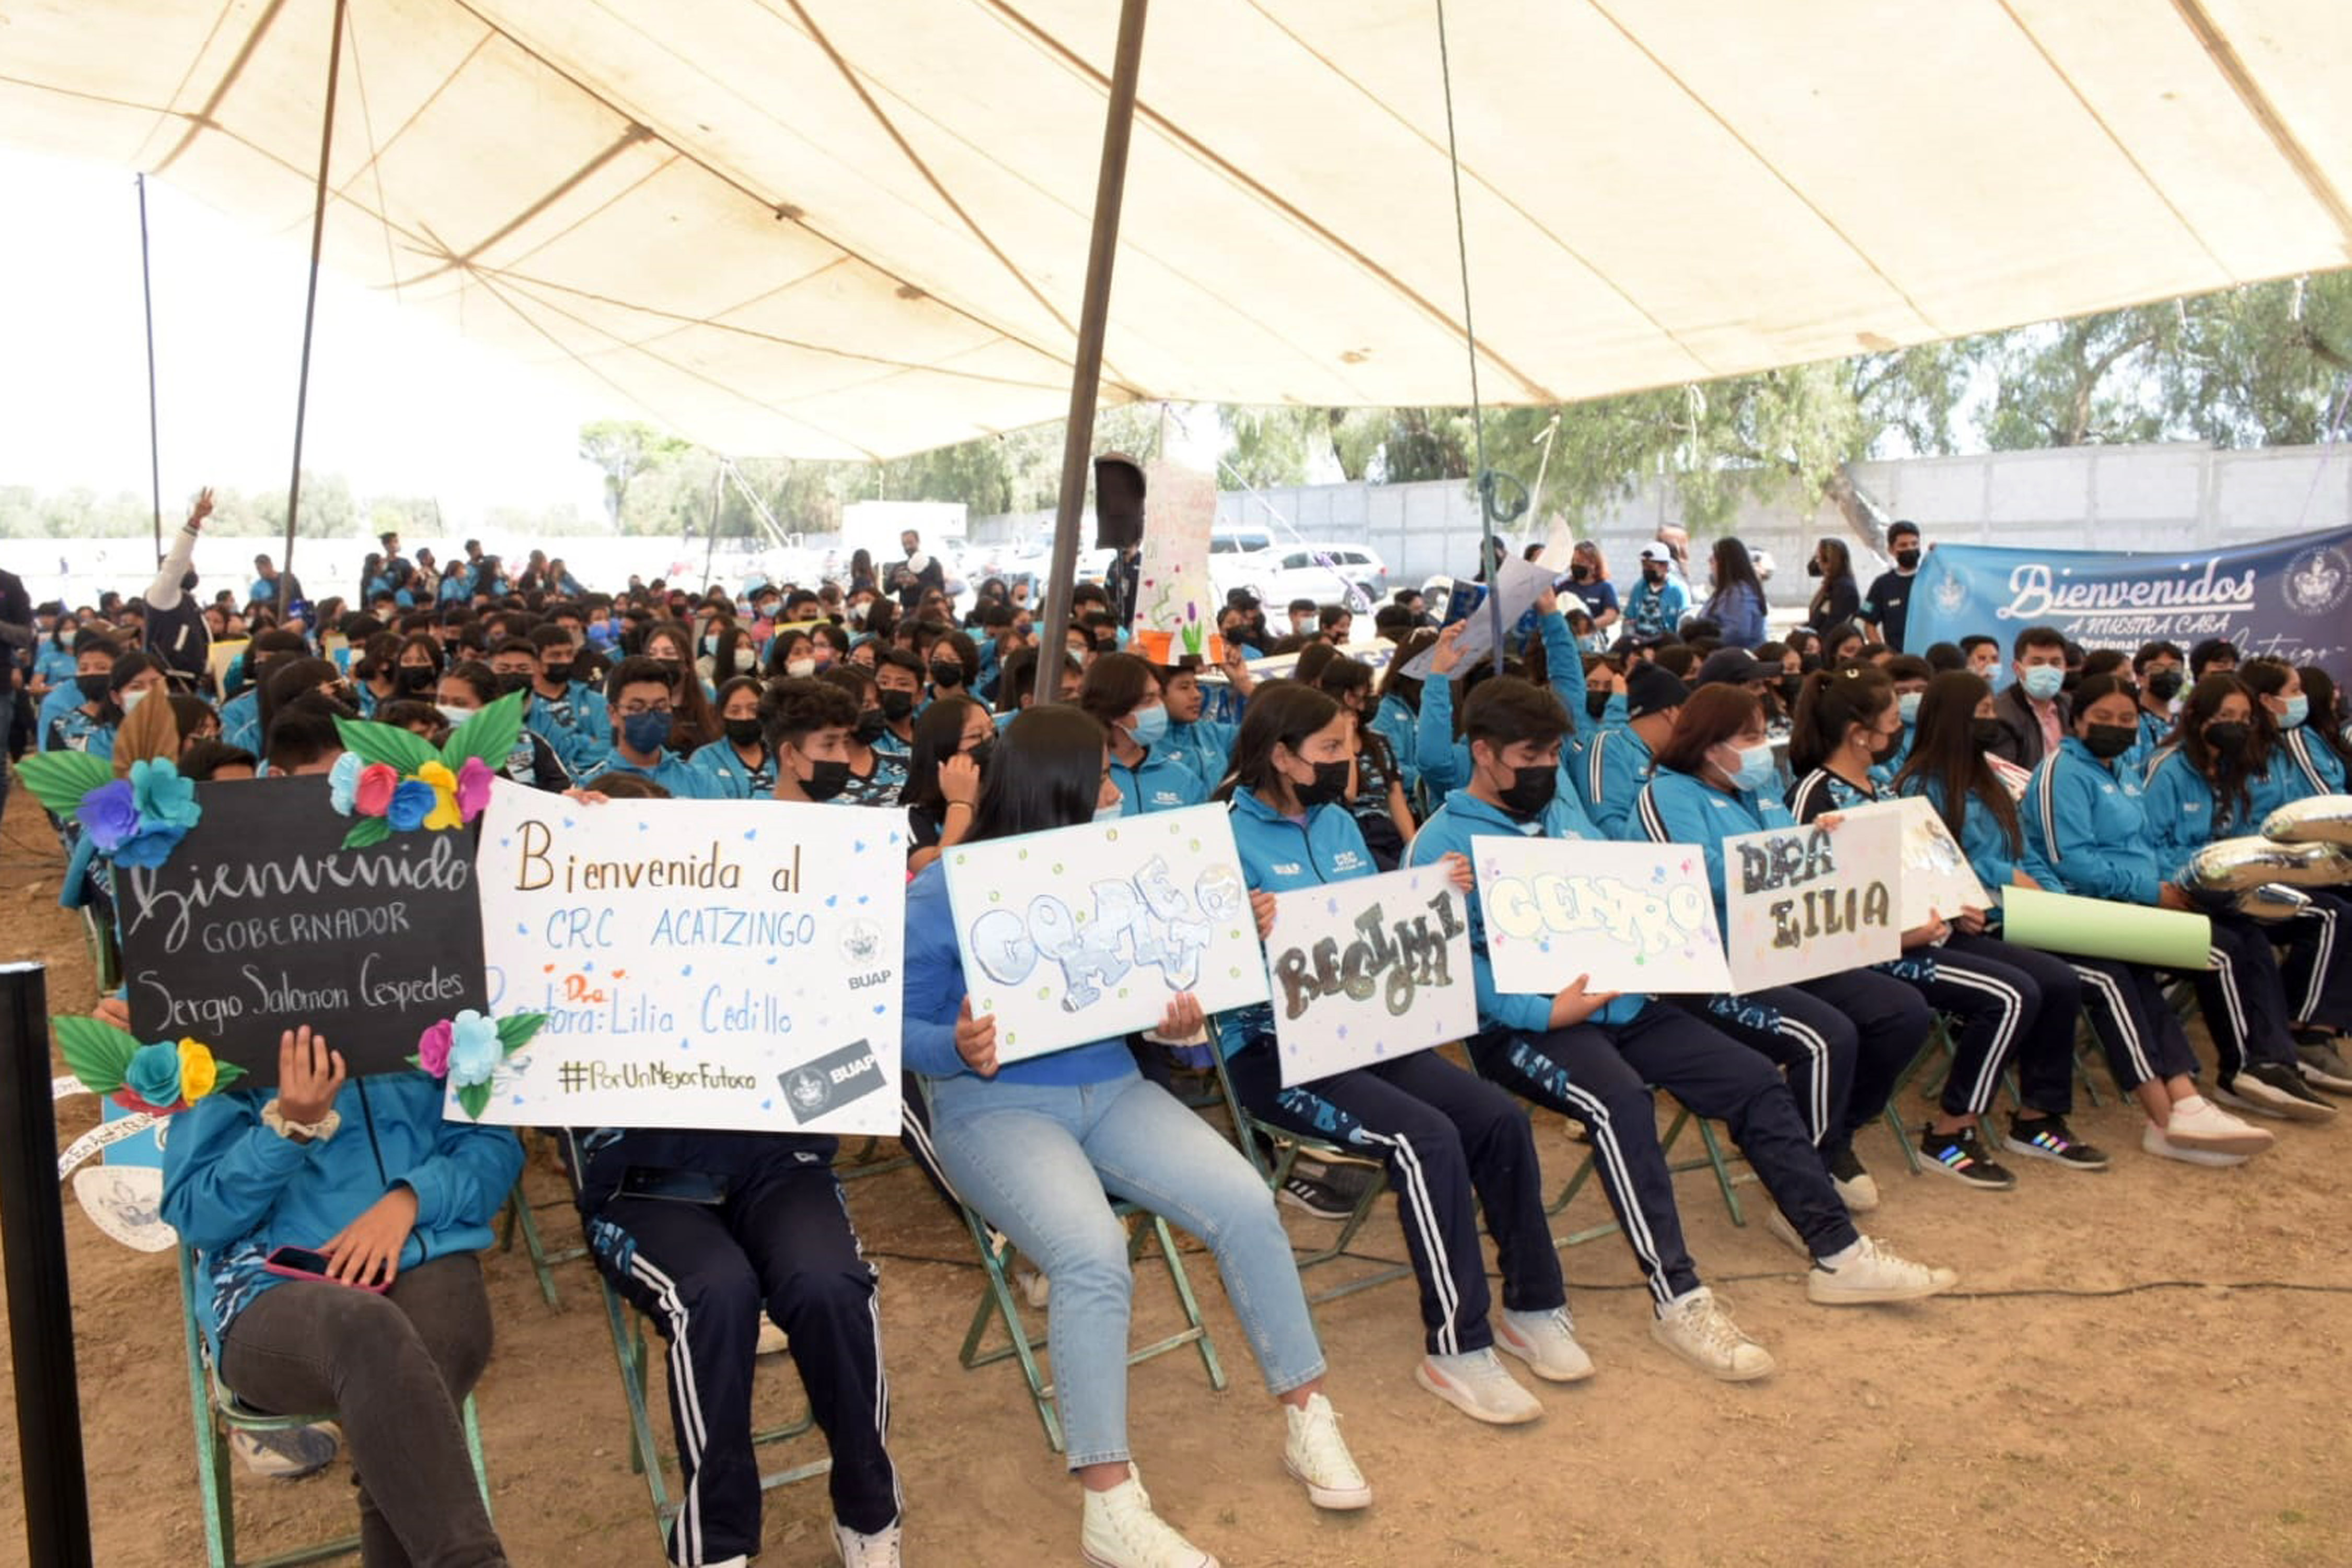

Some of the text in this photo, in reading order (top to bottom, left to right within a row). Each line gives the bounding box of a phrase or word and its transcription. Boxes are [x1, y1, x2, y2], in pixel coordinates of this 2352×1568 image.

[1996, 557, 2255, 620] Bienvenidos
[515, 820, 801, 893] Bienvenida al
[1736, 828, 1836, 894] DRA
[203, 901, 410, 953] GOBERNADOR
[546, 907, 815, 949] CRC ACATZINGO
[1487, 873, 1706, 955] CENTRO
[1770, 881, 1889, 948] LILIA
[139, 970, 244, 1036] Sergio
[700, 984, 792, 1035] Cedillo
[848, 970, 892, 990] BUAP
[831, 1054, 877, 1086] BUAP
